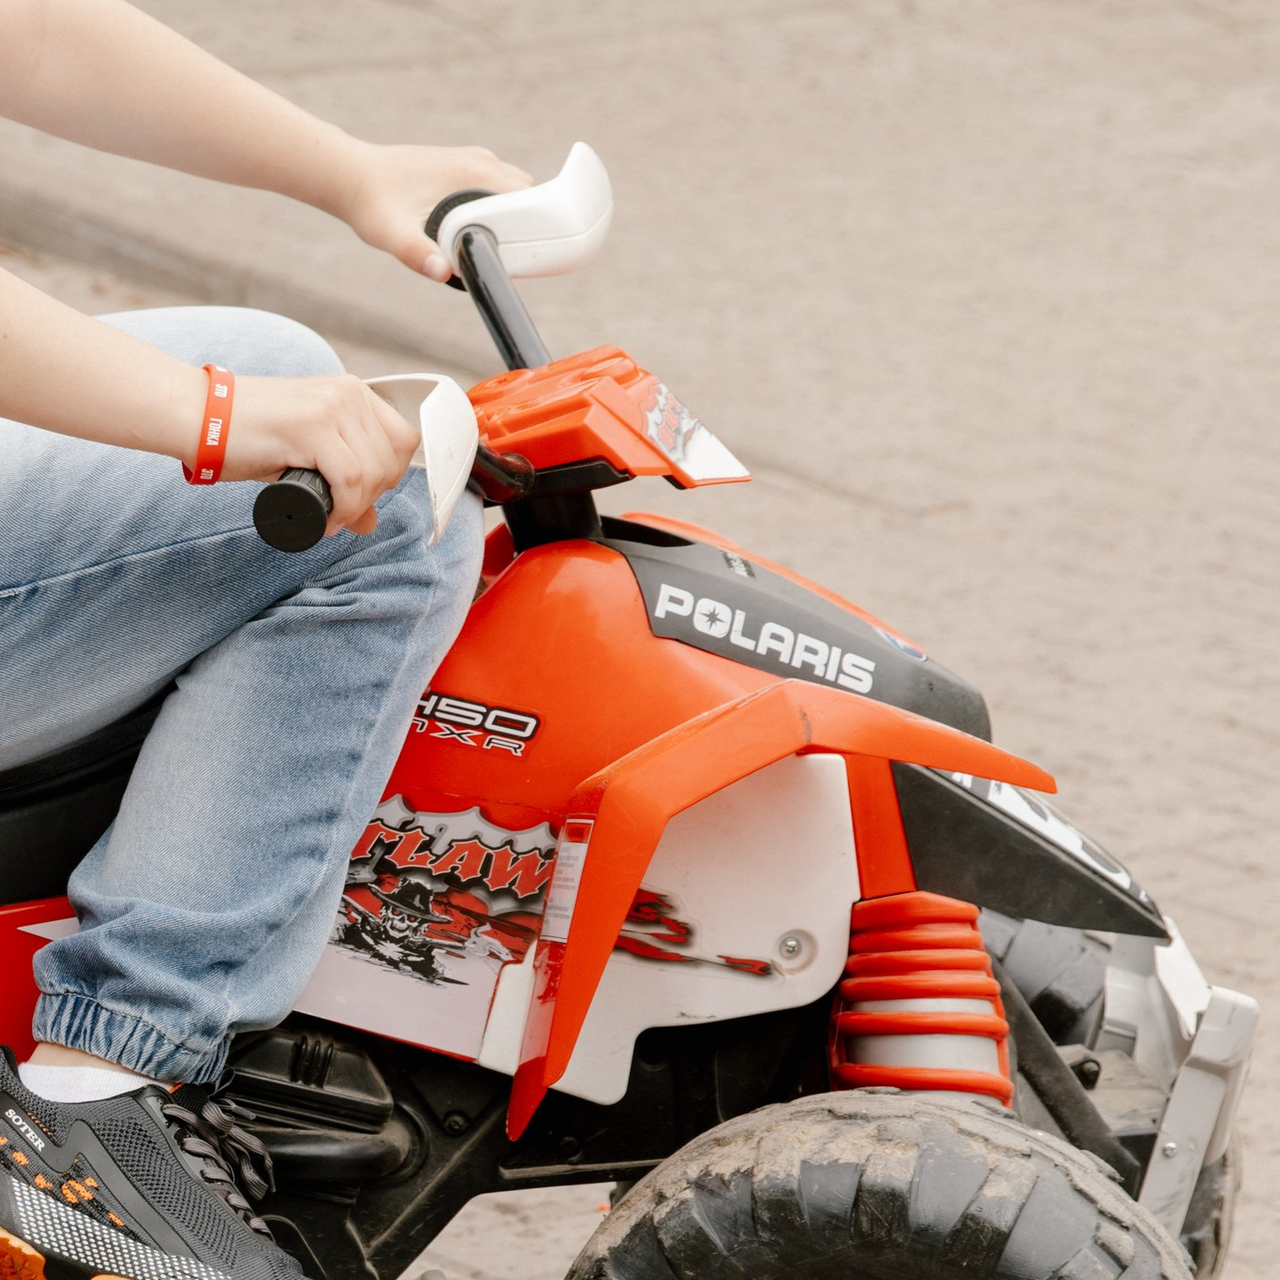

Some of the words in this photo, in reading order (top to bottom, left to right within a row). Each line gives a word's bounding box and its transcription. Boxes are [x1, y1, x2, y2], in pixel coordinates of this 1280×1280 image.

[214, 383, 228, 398] ЭТО
[206, 417, 222, 445] ГОНКА
[654, 583, 876, 694] POLARIS
[351, 821, 555, 899] TLAW
[4, 1108, 45, 1152] SOTER
